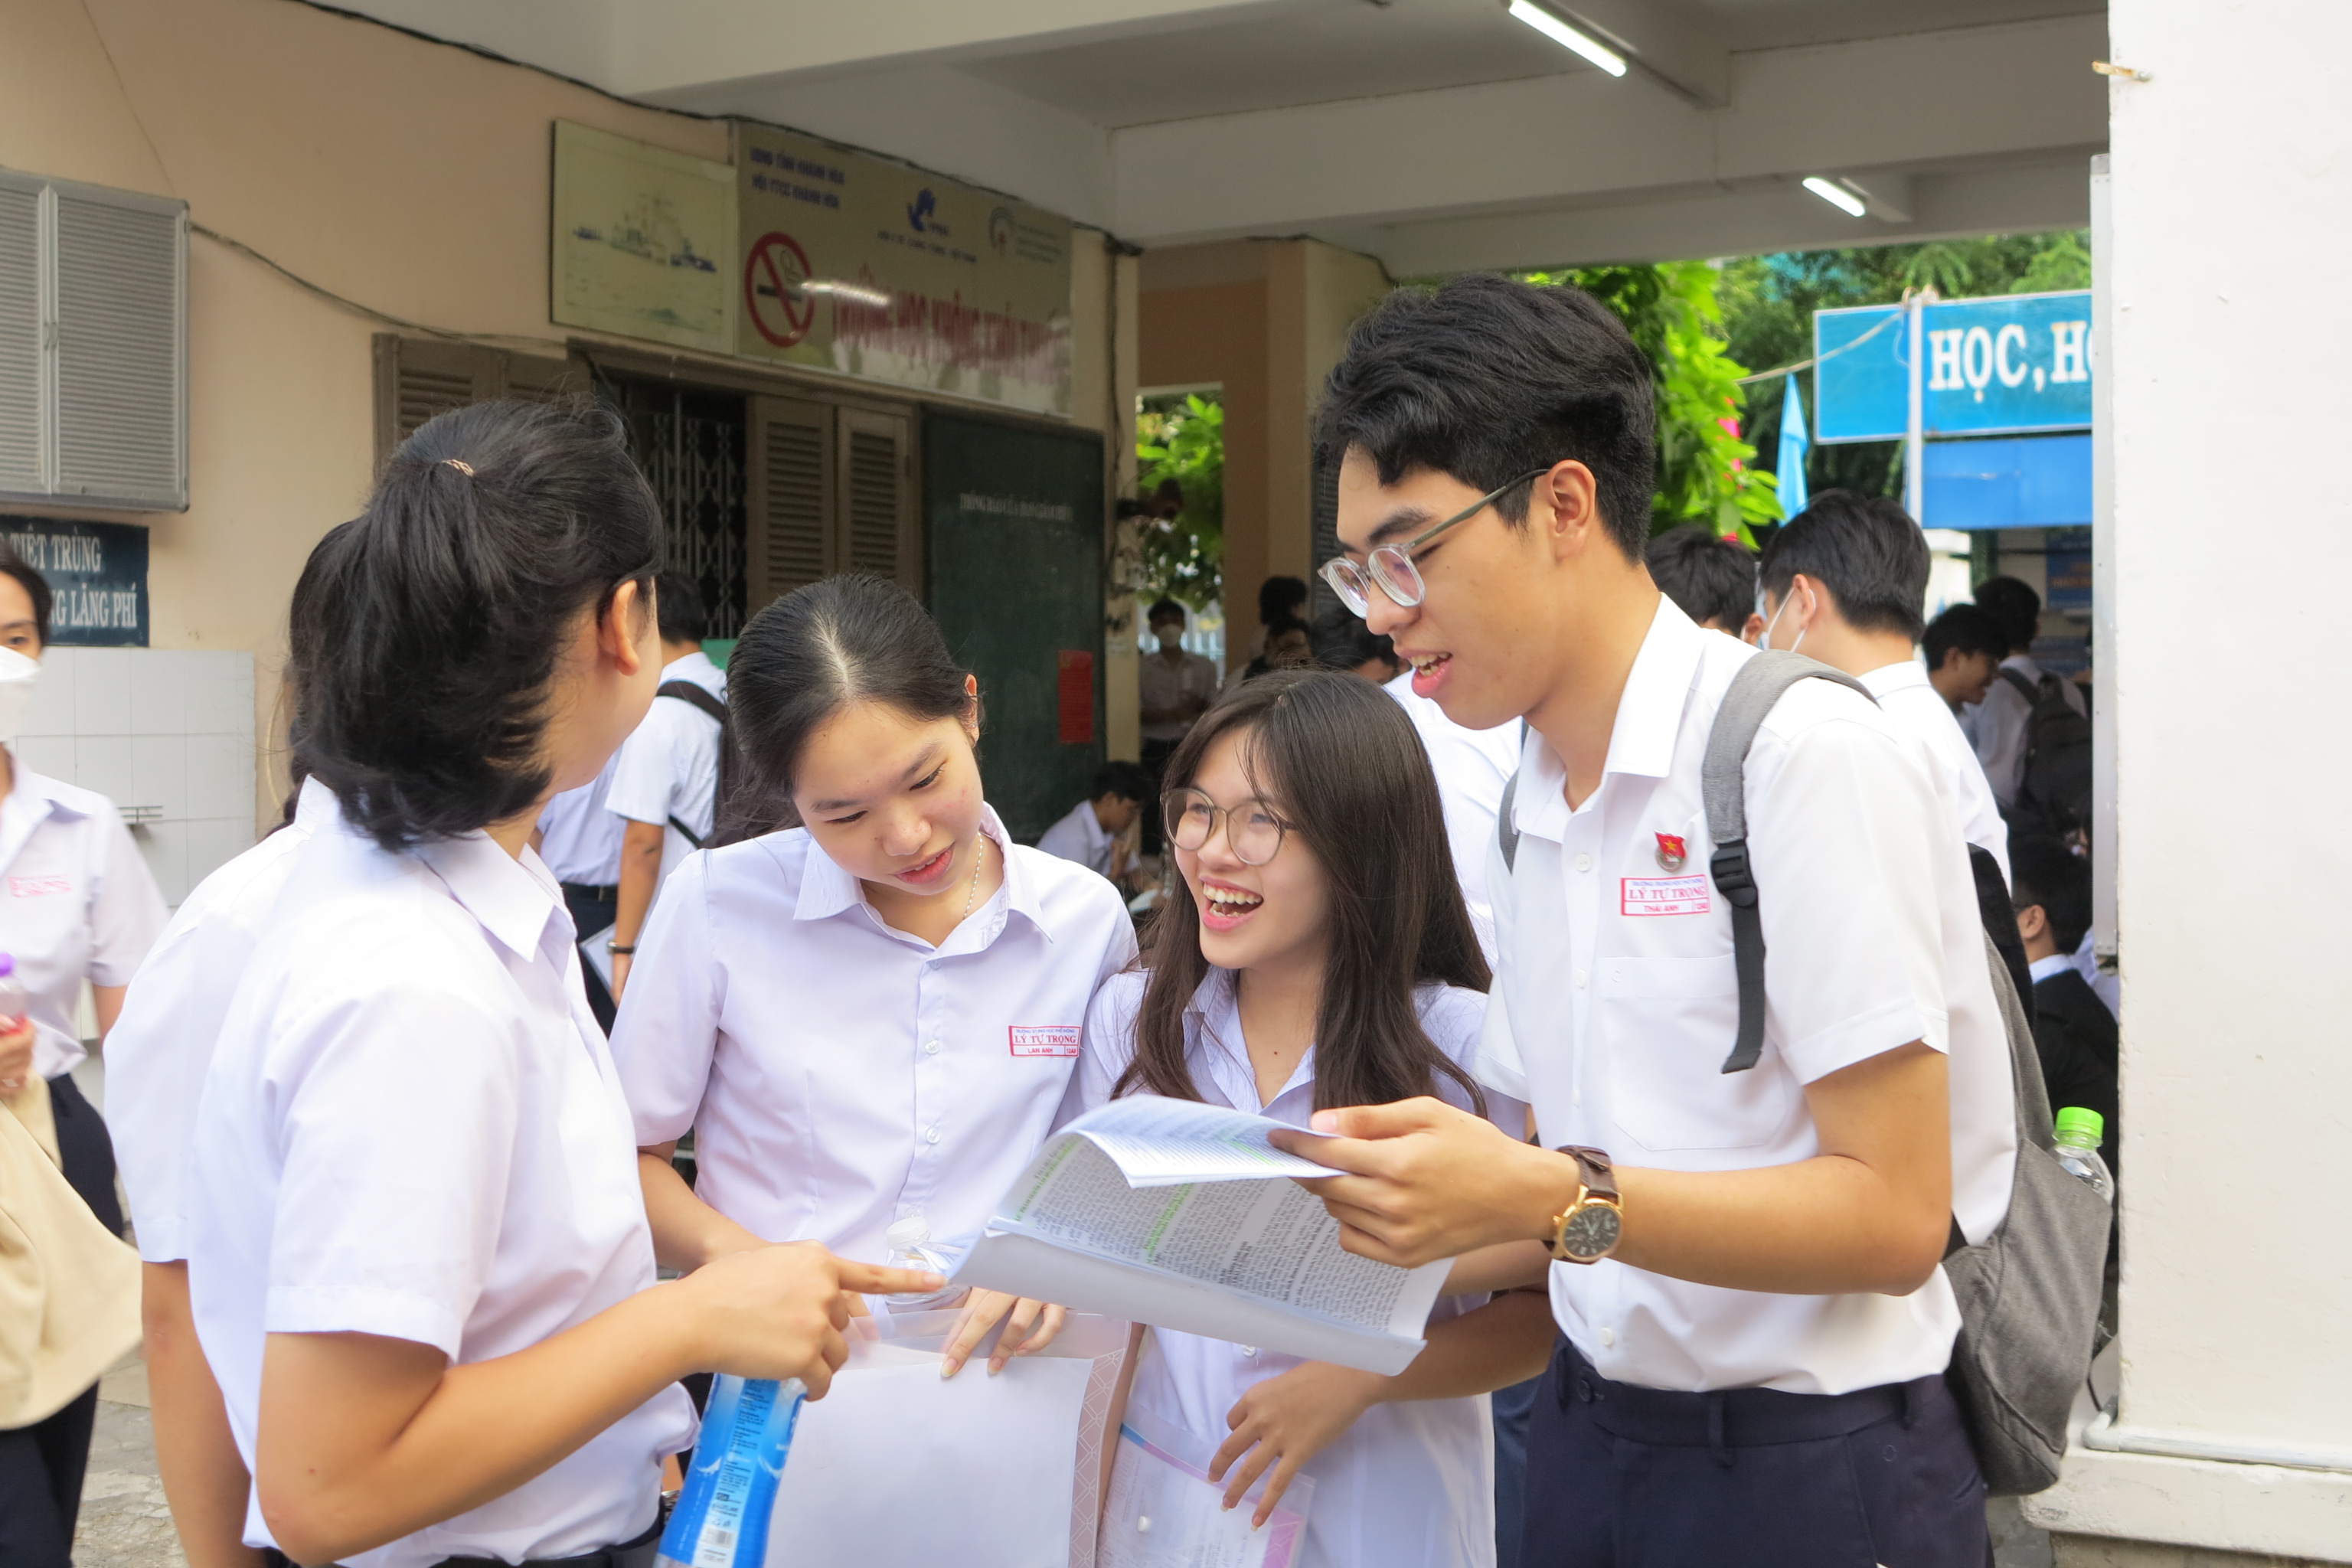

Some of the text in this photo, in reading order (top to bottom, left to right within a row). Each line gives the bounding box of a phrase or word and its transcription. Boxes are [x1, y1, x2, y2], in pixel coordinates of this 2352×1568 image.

[113, 582, 137, 627] PHÍ
[1014, 1034, 1076, 1044] LÝ TỰ TRỌNG
